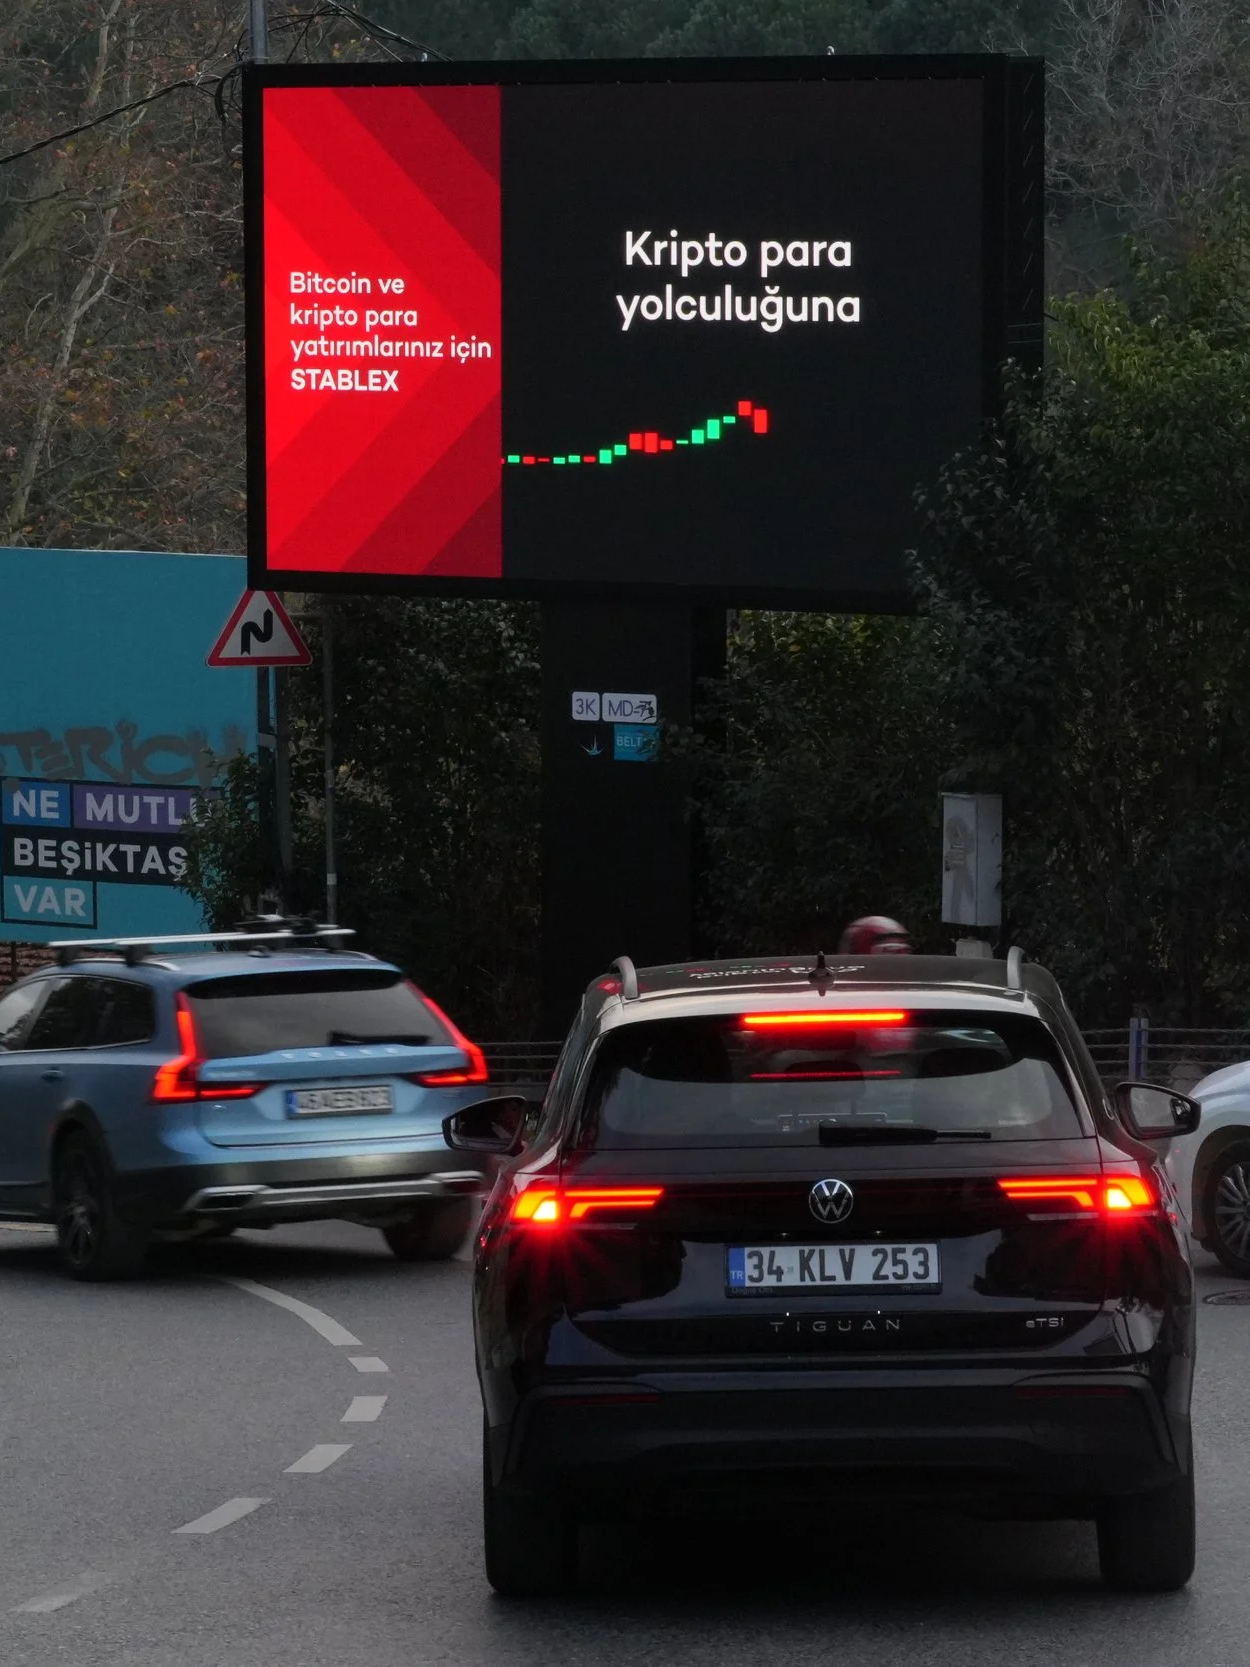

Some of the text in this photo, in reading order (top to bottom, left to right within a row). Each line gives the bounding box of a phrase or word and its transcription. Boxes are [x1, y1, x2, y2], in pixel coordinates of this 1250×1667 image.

[625, 229, 852, 278] Kripto para
[290, 271, 405, 294] Bitcoin ve
[290, 303, 418, 332] kripto para
[615, 283, 860, 333] yolculuğuna
[290, 334, 492, 363] yatırımlarınız için
[291, 368, 400, 392] STABLEX
[575, 698, 597, 716] 3K
[12, 789, 60, 819] NE
[14, 883, 87, 917] VAR
[730, 1270, 744, 1280] TR
[746, 1247, 931, 1283] 34 KLV 253
[769, 1318, 901, 1333] TIGUAN
